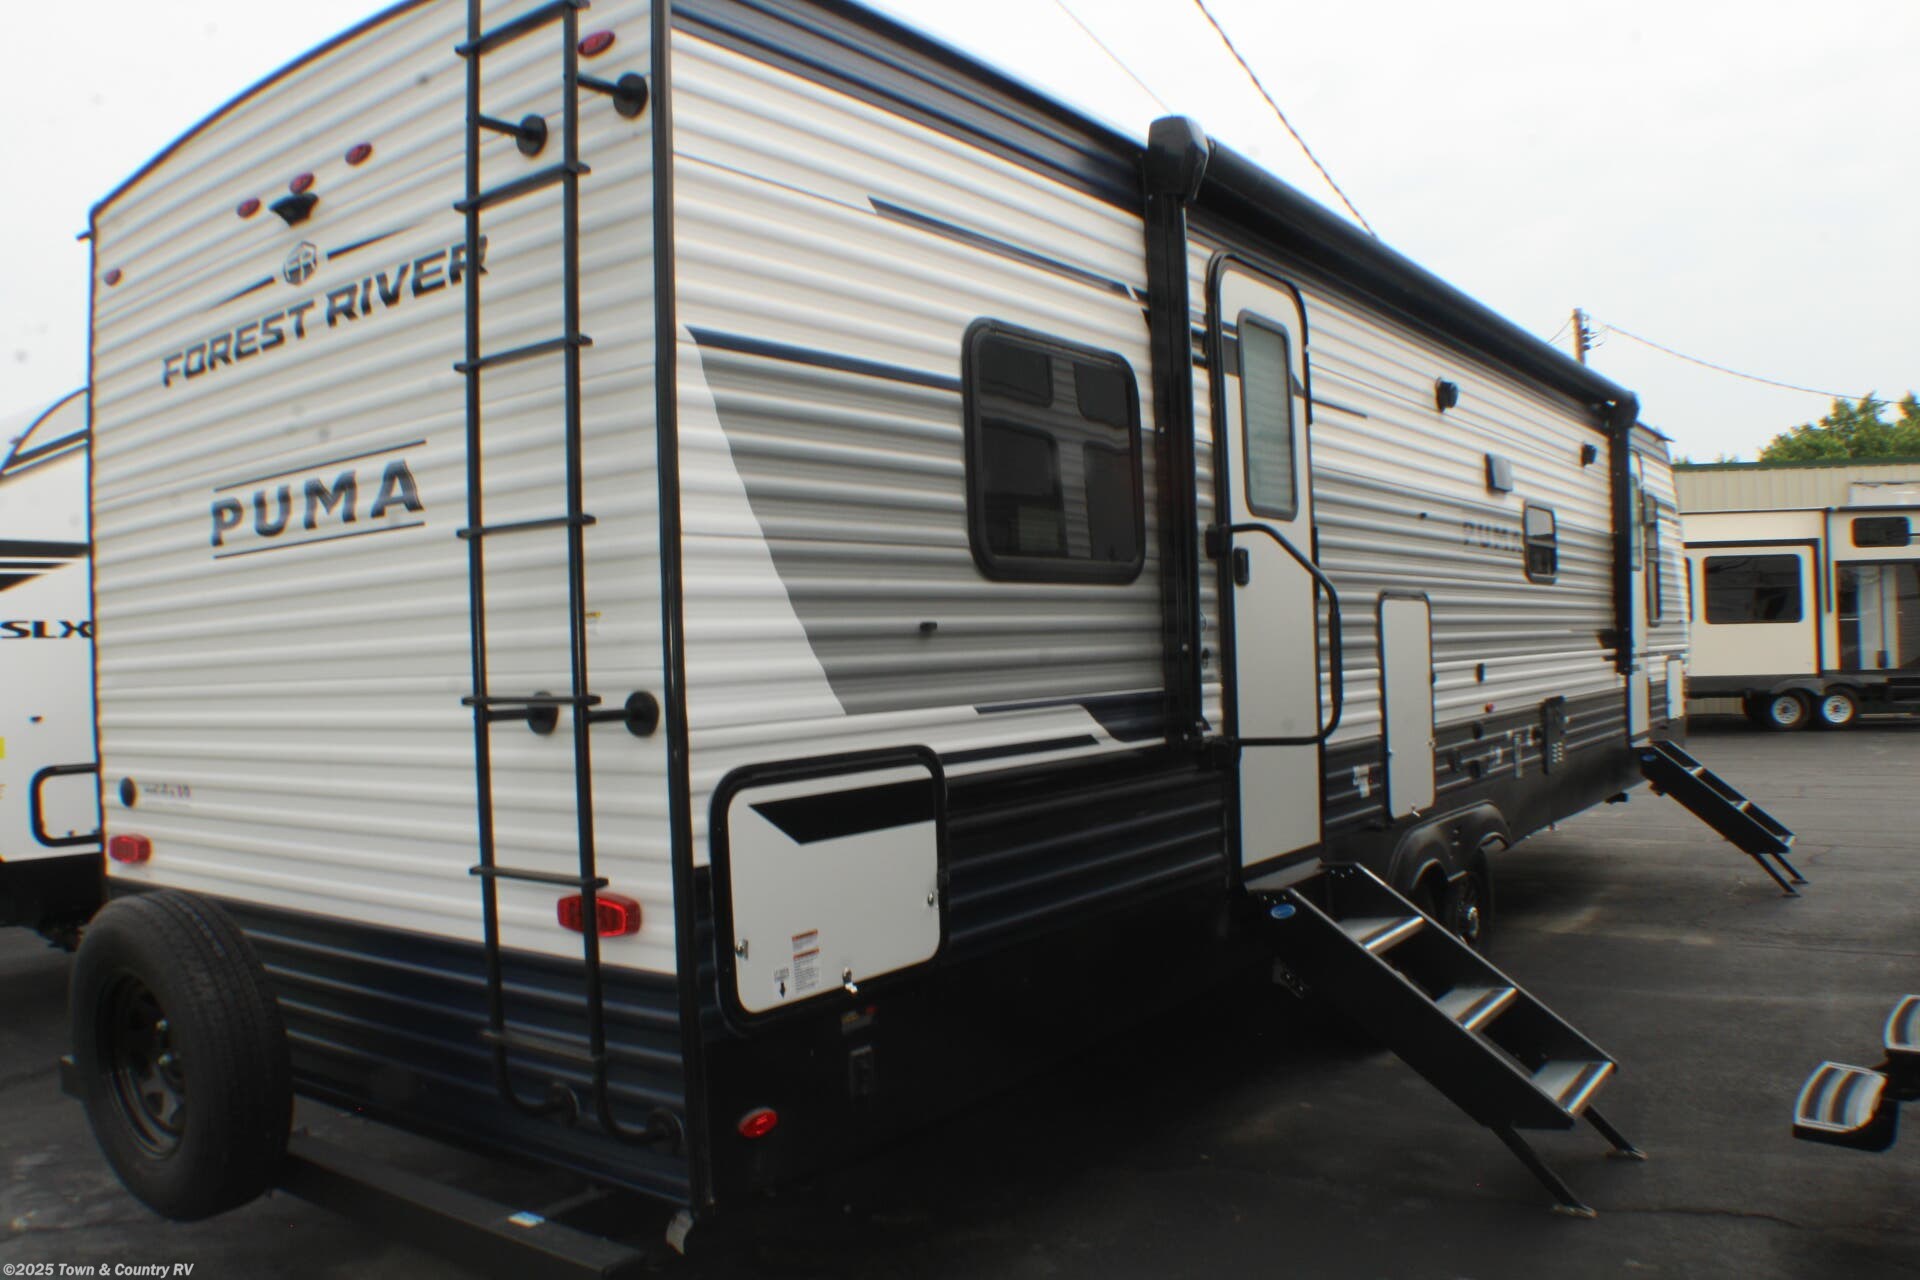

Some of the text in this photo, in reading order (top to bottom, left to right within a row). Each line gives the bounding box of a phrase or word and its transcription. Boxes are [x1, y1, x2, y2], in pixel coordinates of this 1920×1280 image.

[163, 235, 488, 388] FOREST RIVER
[210, 460, 424, 547] PUMA
[0, 621, 92, 639] SLX
